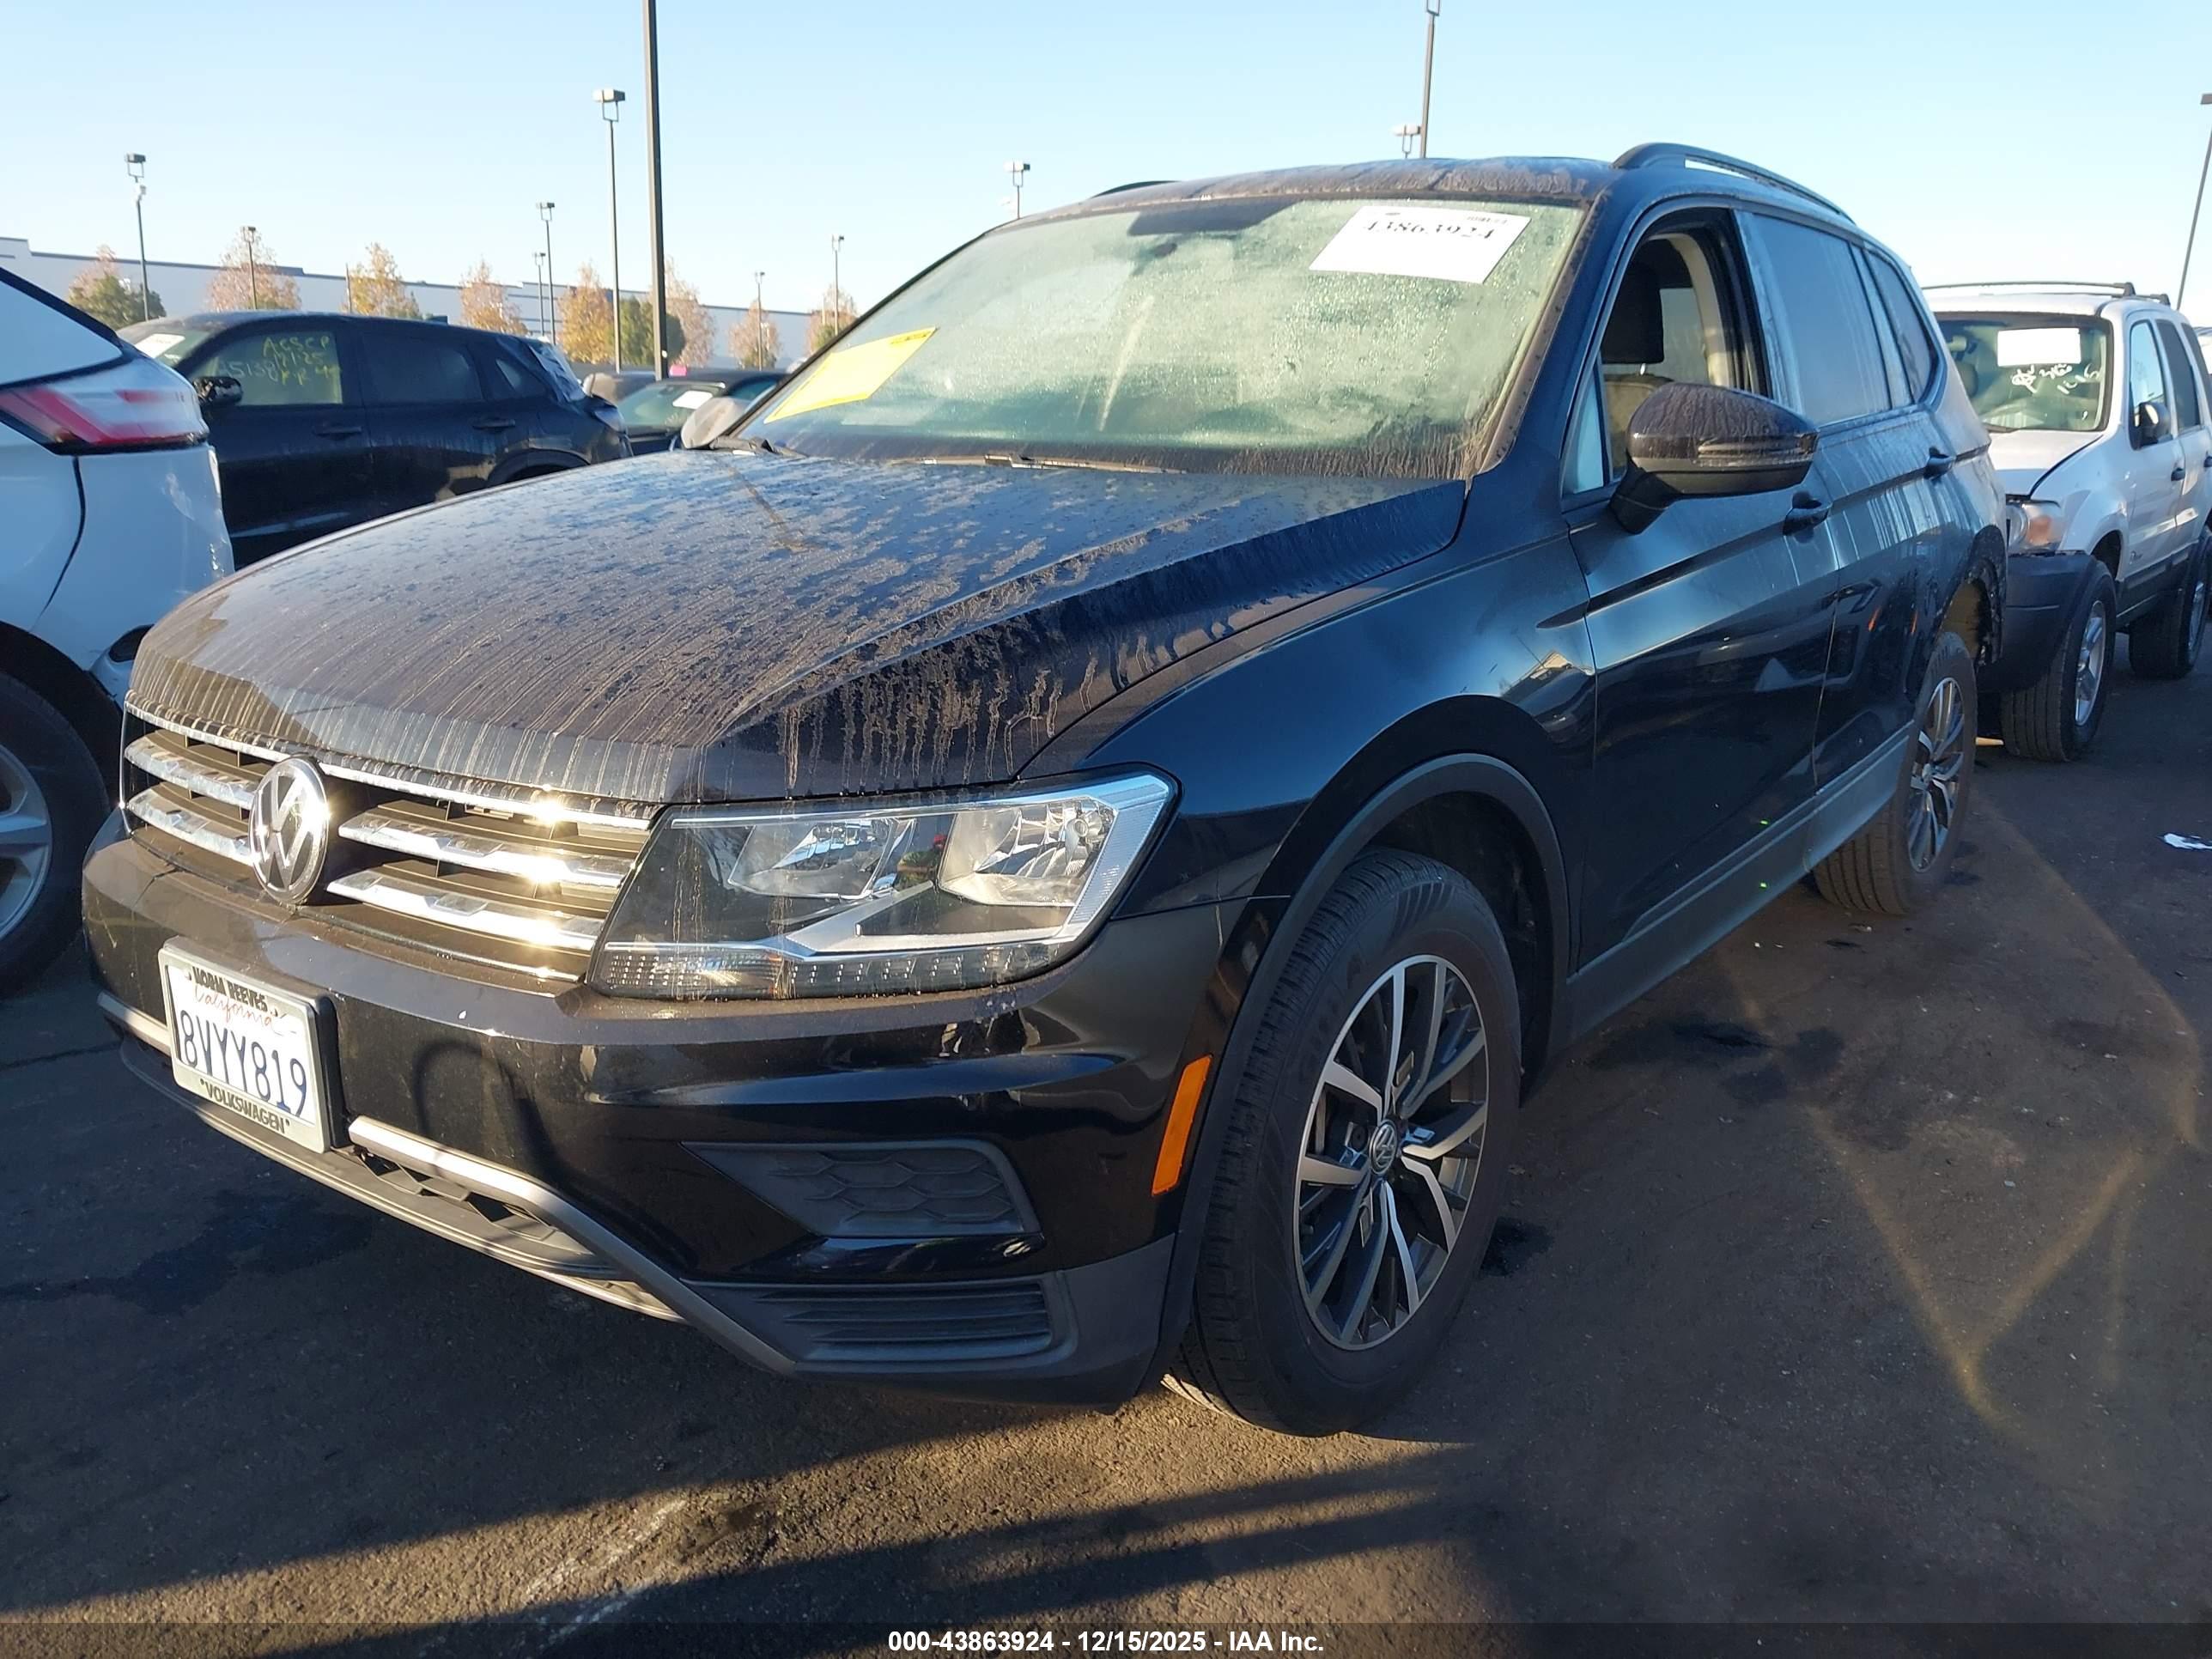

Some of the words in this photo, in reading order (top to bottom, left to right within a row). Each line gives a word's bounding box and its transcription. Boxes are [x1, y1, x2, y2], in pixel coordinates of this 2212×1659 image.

[192, 966, 227, 997] NORM
[226, 979, 268, 1012] REEVES
[180, 1010, 307, 1118] 8VYY819
[205, 1081, 285, 1134] VOLKSWAGEN
